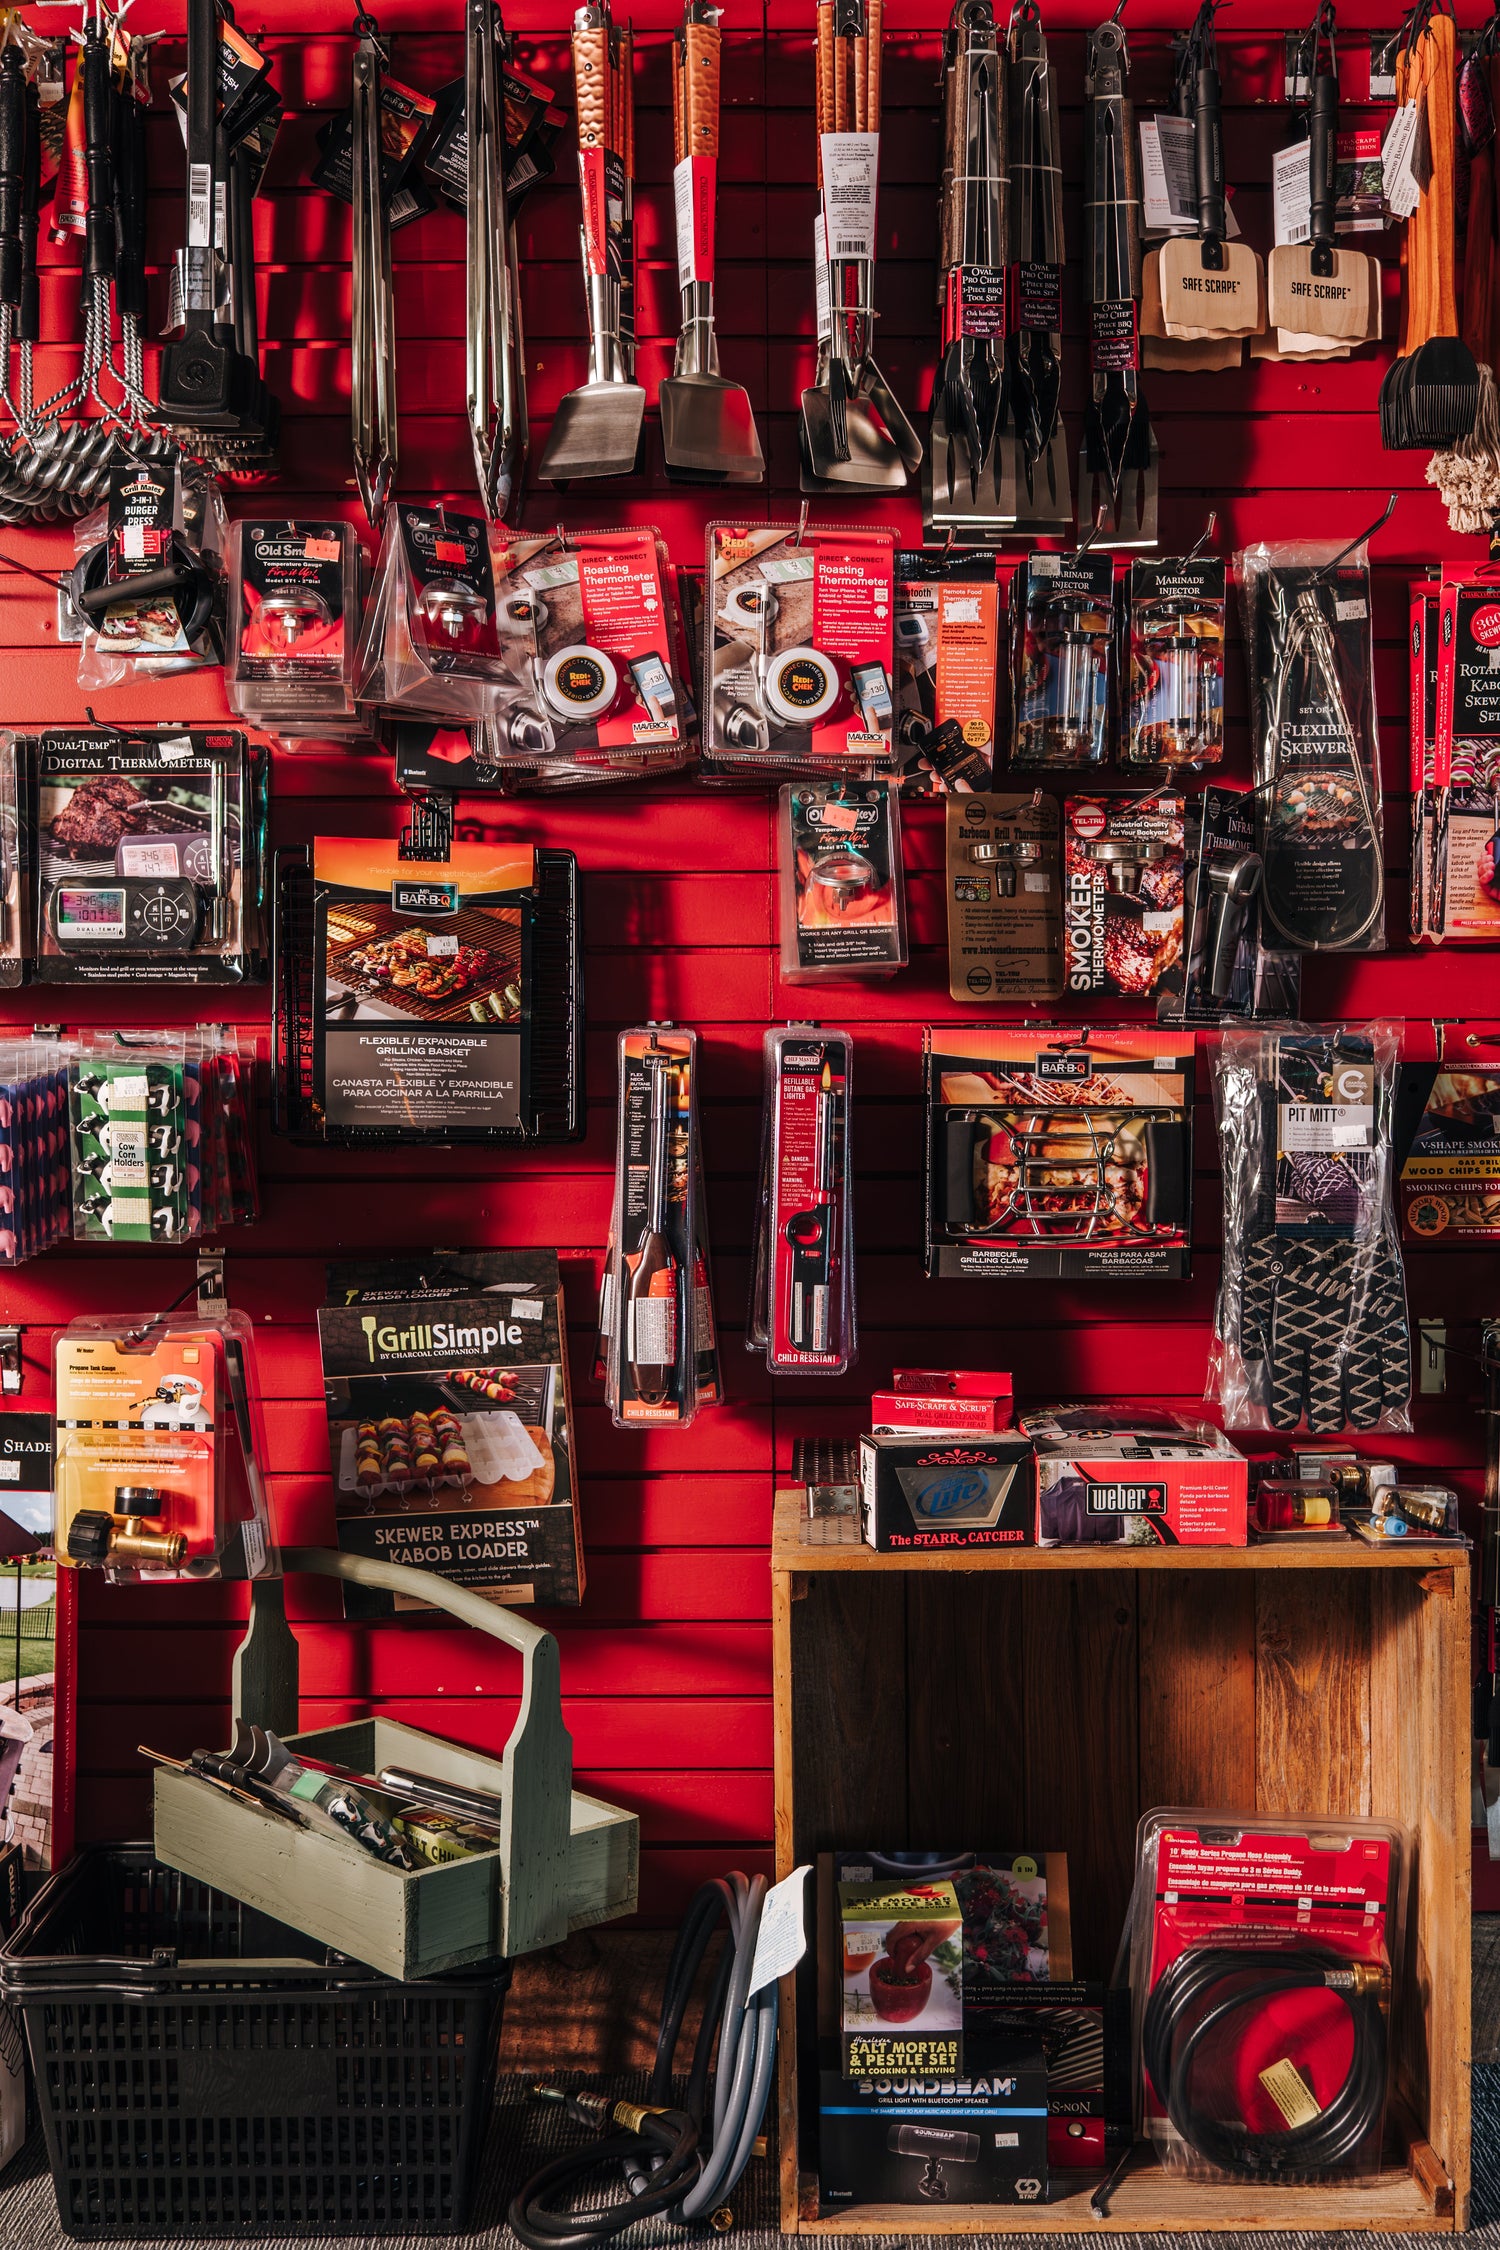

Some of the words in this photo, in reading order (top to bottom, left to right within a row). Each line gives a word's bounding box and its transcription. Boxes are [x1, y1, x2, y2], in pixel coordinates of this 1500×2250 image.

[971, 268, 993, 276] OVAL
[1102, 304, 1122, 312] OVAL
[124, 485, 138, 493] Grill
[140, 485, 161, 493] Mates
[125, 506, 157, 515] BURGER
[128, 517, 153, 526] PRESS
[258, 545, 281, 556] Old
[584, 565, 629, 575] Roasting
[819, 565, 863, 576] Roasting
[585, 573, 654, 585] Thermometer
[819, 576, 888, 586] Thermometer
[1156, 576, 1204, 585] MARINADE
[1052, 581, 1089, 589] INJECTOR
[570, 679, 591, 687] CHEK
[792, 683, 813, 691] CHEK
[871, 685, 884, 693] 130
[634, 721, 669, 730] MAVERICK
[1280, 722, 1354, 740] FLEXIBLE
[47, 757, 104, 770] DIGITAL
[108, 757, 211, 770] THERMOMETER
[1071, 873, 1090, 990] SMOKER
[1093, 876, 1104, 987] THERMOMETER
[360, 1037, 409, 1045] FLEXIBLE
[418, 1038, 487, 1047] EXPANDABLE
[377, 1047, 425, 1055] GRILLING
[429, 1048, 470, 1056] BASKET
[333, 1079, 382, 1087] CANASTA
[449, 1080, 513, 1089] EXPANDIBLE
[343, 1089, 370, 1097] PARA
[374, 1089, 422, 1097] COCINAR
[118, 1143, 135, 1151] Cow
[118, 1150, 136, 1159] Corn
[114, 1159, 144, 1167] Holders
[377, 1321, 522, 1353] GrillSimple
[392, 1351, 432, 1359] CHARCOAL
[777, 1353, 800, 1363] CHILD
[802, 1353, 836, 1363] RESISTANT
[627, 1408, 644, 1417] CHILD
[645, 1408, 675, 1418] RESISTANT
[917, 1419, 965, 1427] REPLACEMENT
[930, 1483, 978, 1513] Lite
[1092, 1484, 1146, 1510] weber
[890, 1535, 911, 1546] The
[914, 1533, 966, 1545] STARR
[968, 1530, 1024, 1541] CATCHER
[390, 1546, 452, 1564] KABOB
[459, 1541, 528, 1560] LOADER
[1181, 1848, 1199, 1856] Buddy
[1200, 1849, 1220, 1857] Series
[1222, 1850, 1246, 1859] Propane
[1248, 1851, 1262, 1859] Hose
[1264, 1852, 1291, 1861] Assembly
[1211, 1880, 1239, 1889] manguera
[1241, 1882, 1256, 1890] para
[1257, 1882, 1268, 1890] gas
[1295, 1883, 1302, 1891] de
[1314, 1884, 1322, 1892] de
[1323, 1884, 1329, 1892] la
[1347, 1886, 1365, 1895] Buddy
[850, 2042, 886, 2054] SALT
[893, 2042, 957, 2053] MORTAR
[850, 2054, 861, 2066] &
[866, 2054, 923, 2066] PESTLE
[929, 2053, 957, 2065] SET
